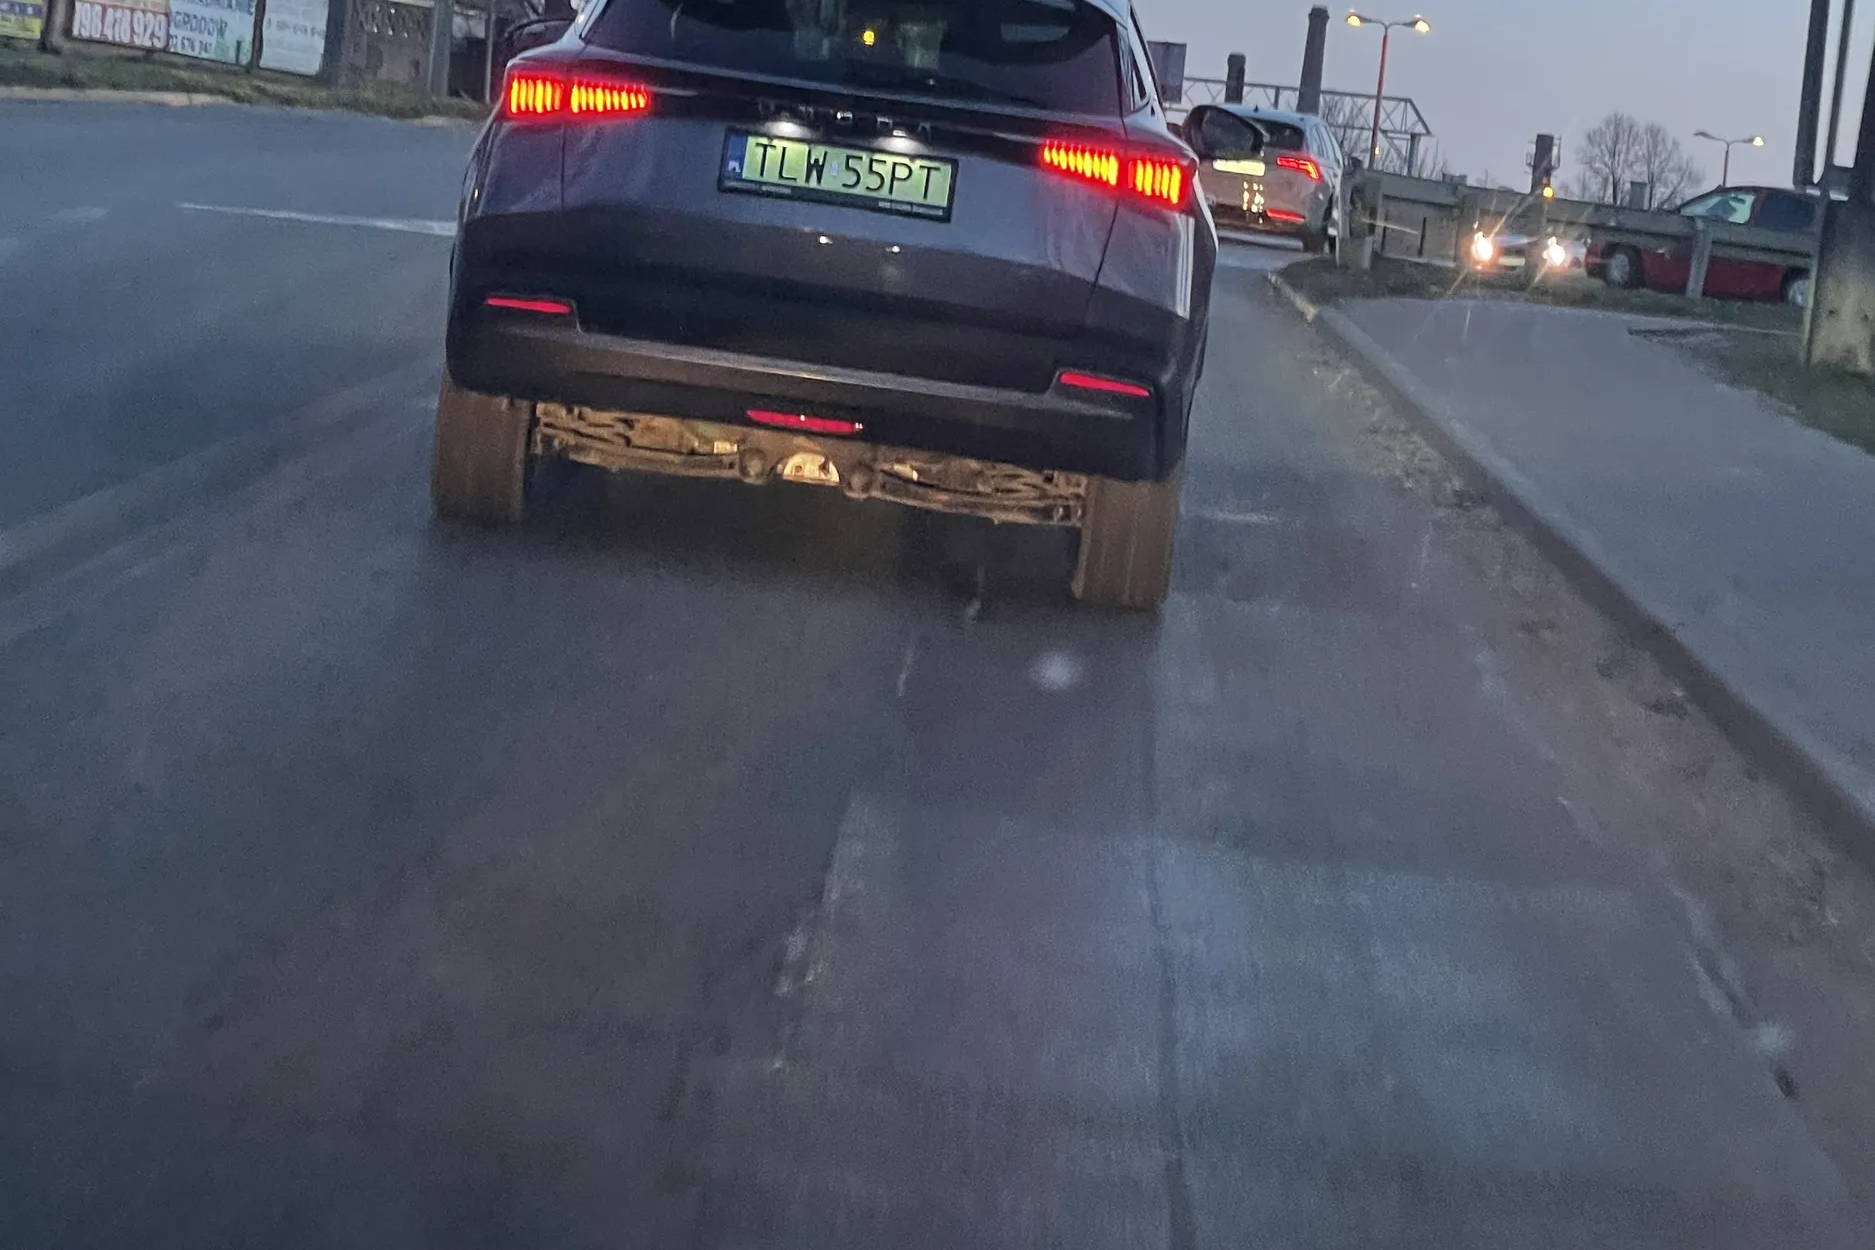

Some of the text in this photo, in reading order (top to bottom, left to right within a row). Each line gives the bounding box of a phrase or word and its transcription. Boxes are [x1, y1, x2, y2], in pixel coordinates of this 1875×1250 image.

[133, 9, 169, 49] 929
[755, 141, 941, 200] TLW 55PT
